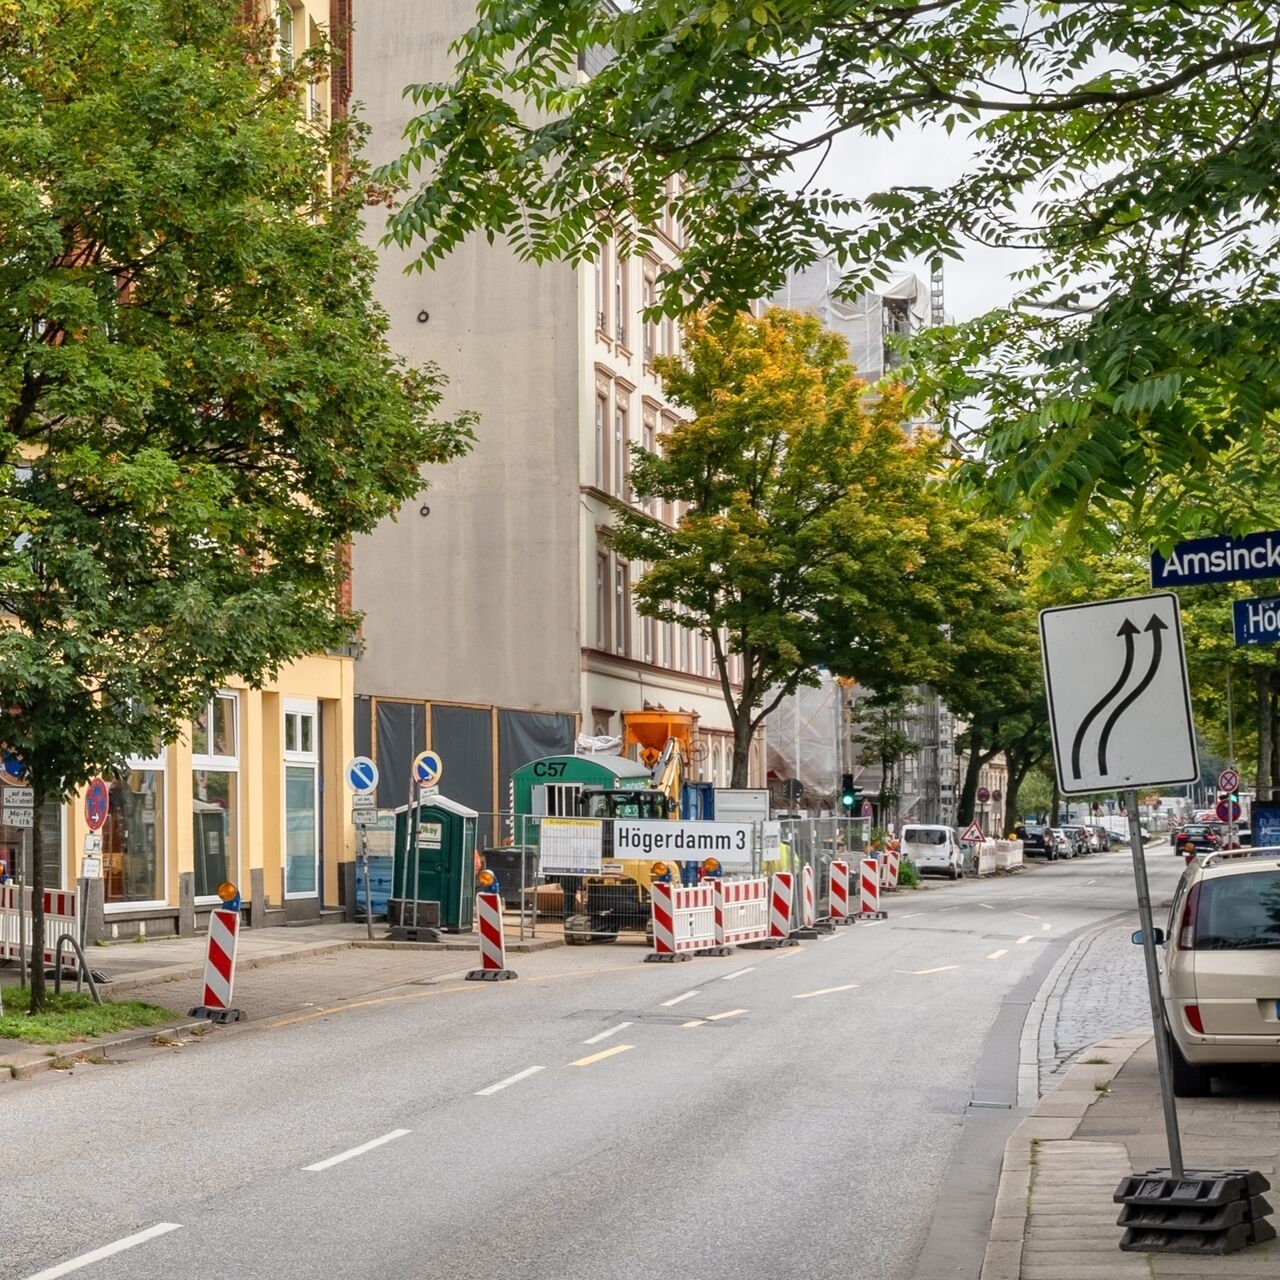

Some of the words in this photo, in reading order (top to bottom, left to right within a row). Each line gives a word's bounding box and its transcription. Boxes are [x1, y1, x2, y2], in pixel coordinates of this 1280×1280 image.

[1162, 538, 1280, 577] Amsinck
[533, 762, 567, 778] C57
[618, 827, 731, 853] Högerdamm
[735, 830, 746, 850] 3
